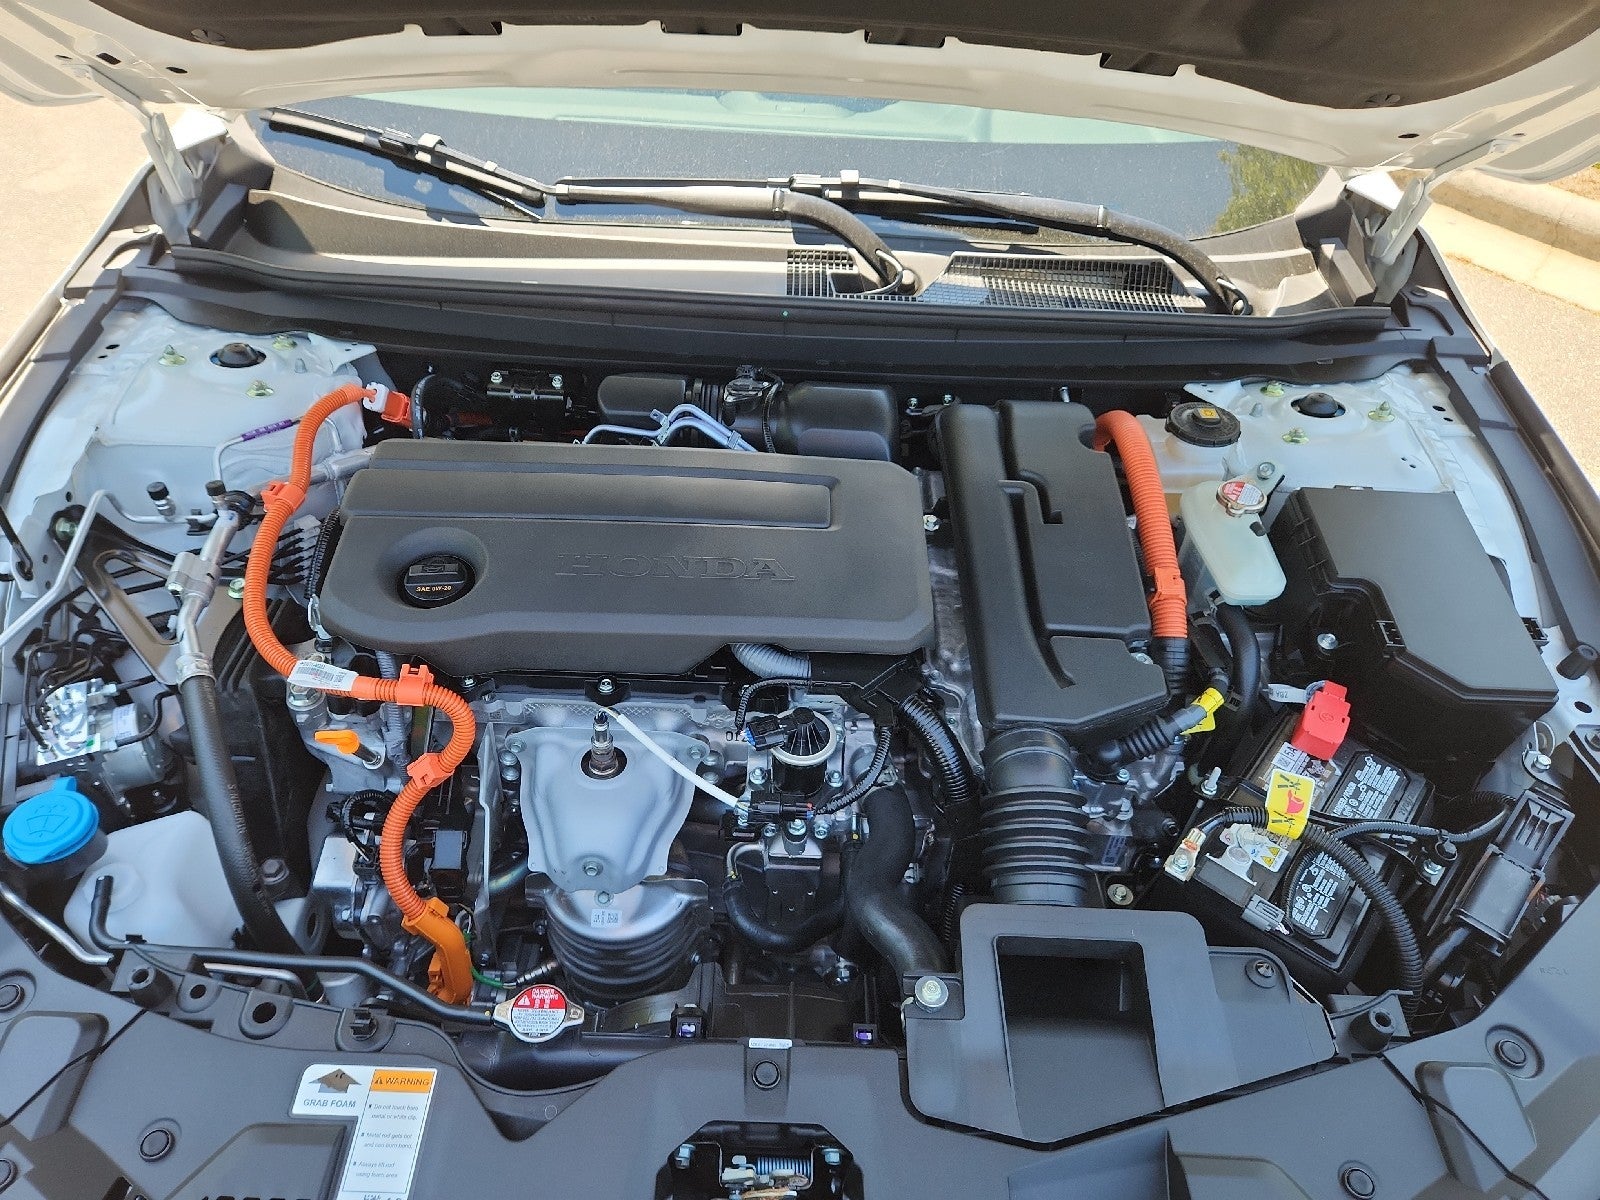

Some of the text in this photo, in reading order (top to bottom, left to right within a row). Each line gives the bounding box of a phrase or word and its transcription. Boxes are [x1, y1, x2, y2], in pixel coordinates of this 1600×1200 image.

[554, 553, 795, 581] HONDA
[385, 1077, 430, 1086] WARNING
[303, 1099, 356, 1108] GRAB FOAM
